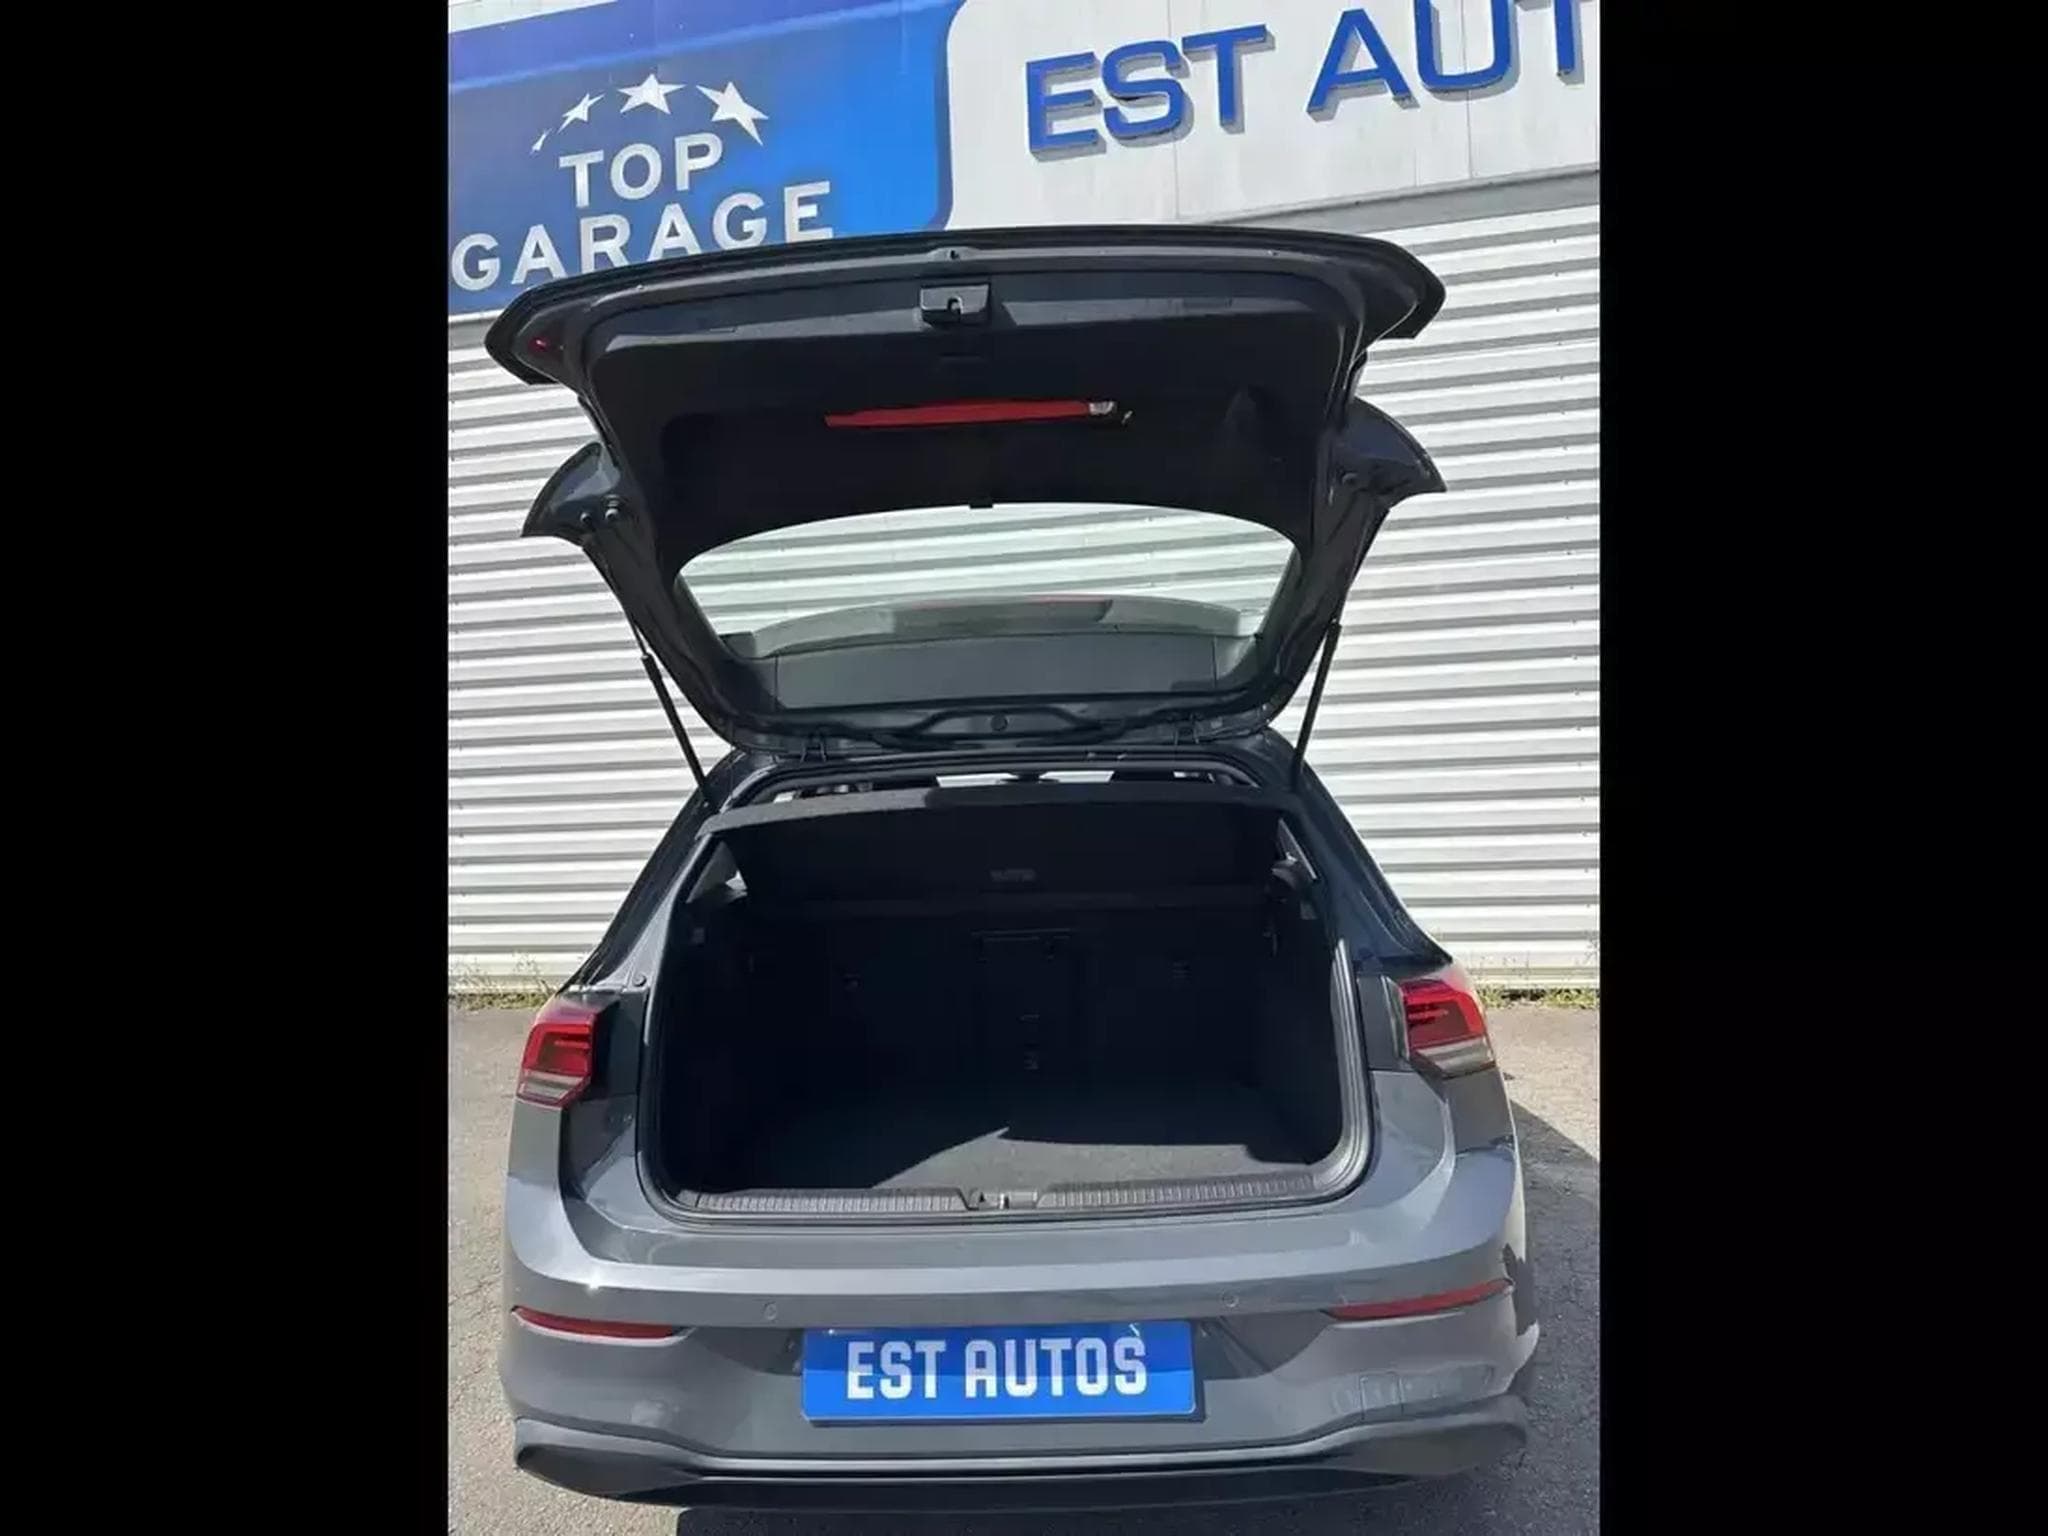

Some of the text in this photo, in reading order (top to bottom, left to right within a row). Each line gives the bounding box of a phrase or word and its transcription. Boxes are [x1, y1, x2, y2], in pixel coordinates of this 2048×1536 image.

[1026, 24, 1271, 157] EST
[559, 132, 723, 208] TOP
[451, 181, 833, 292] GARAGE
[847, 1337, 1147, 1399] EST AUTOS
